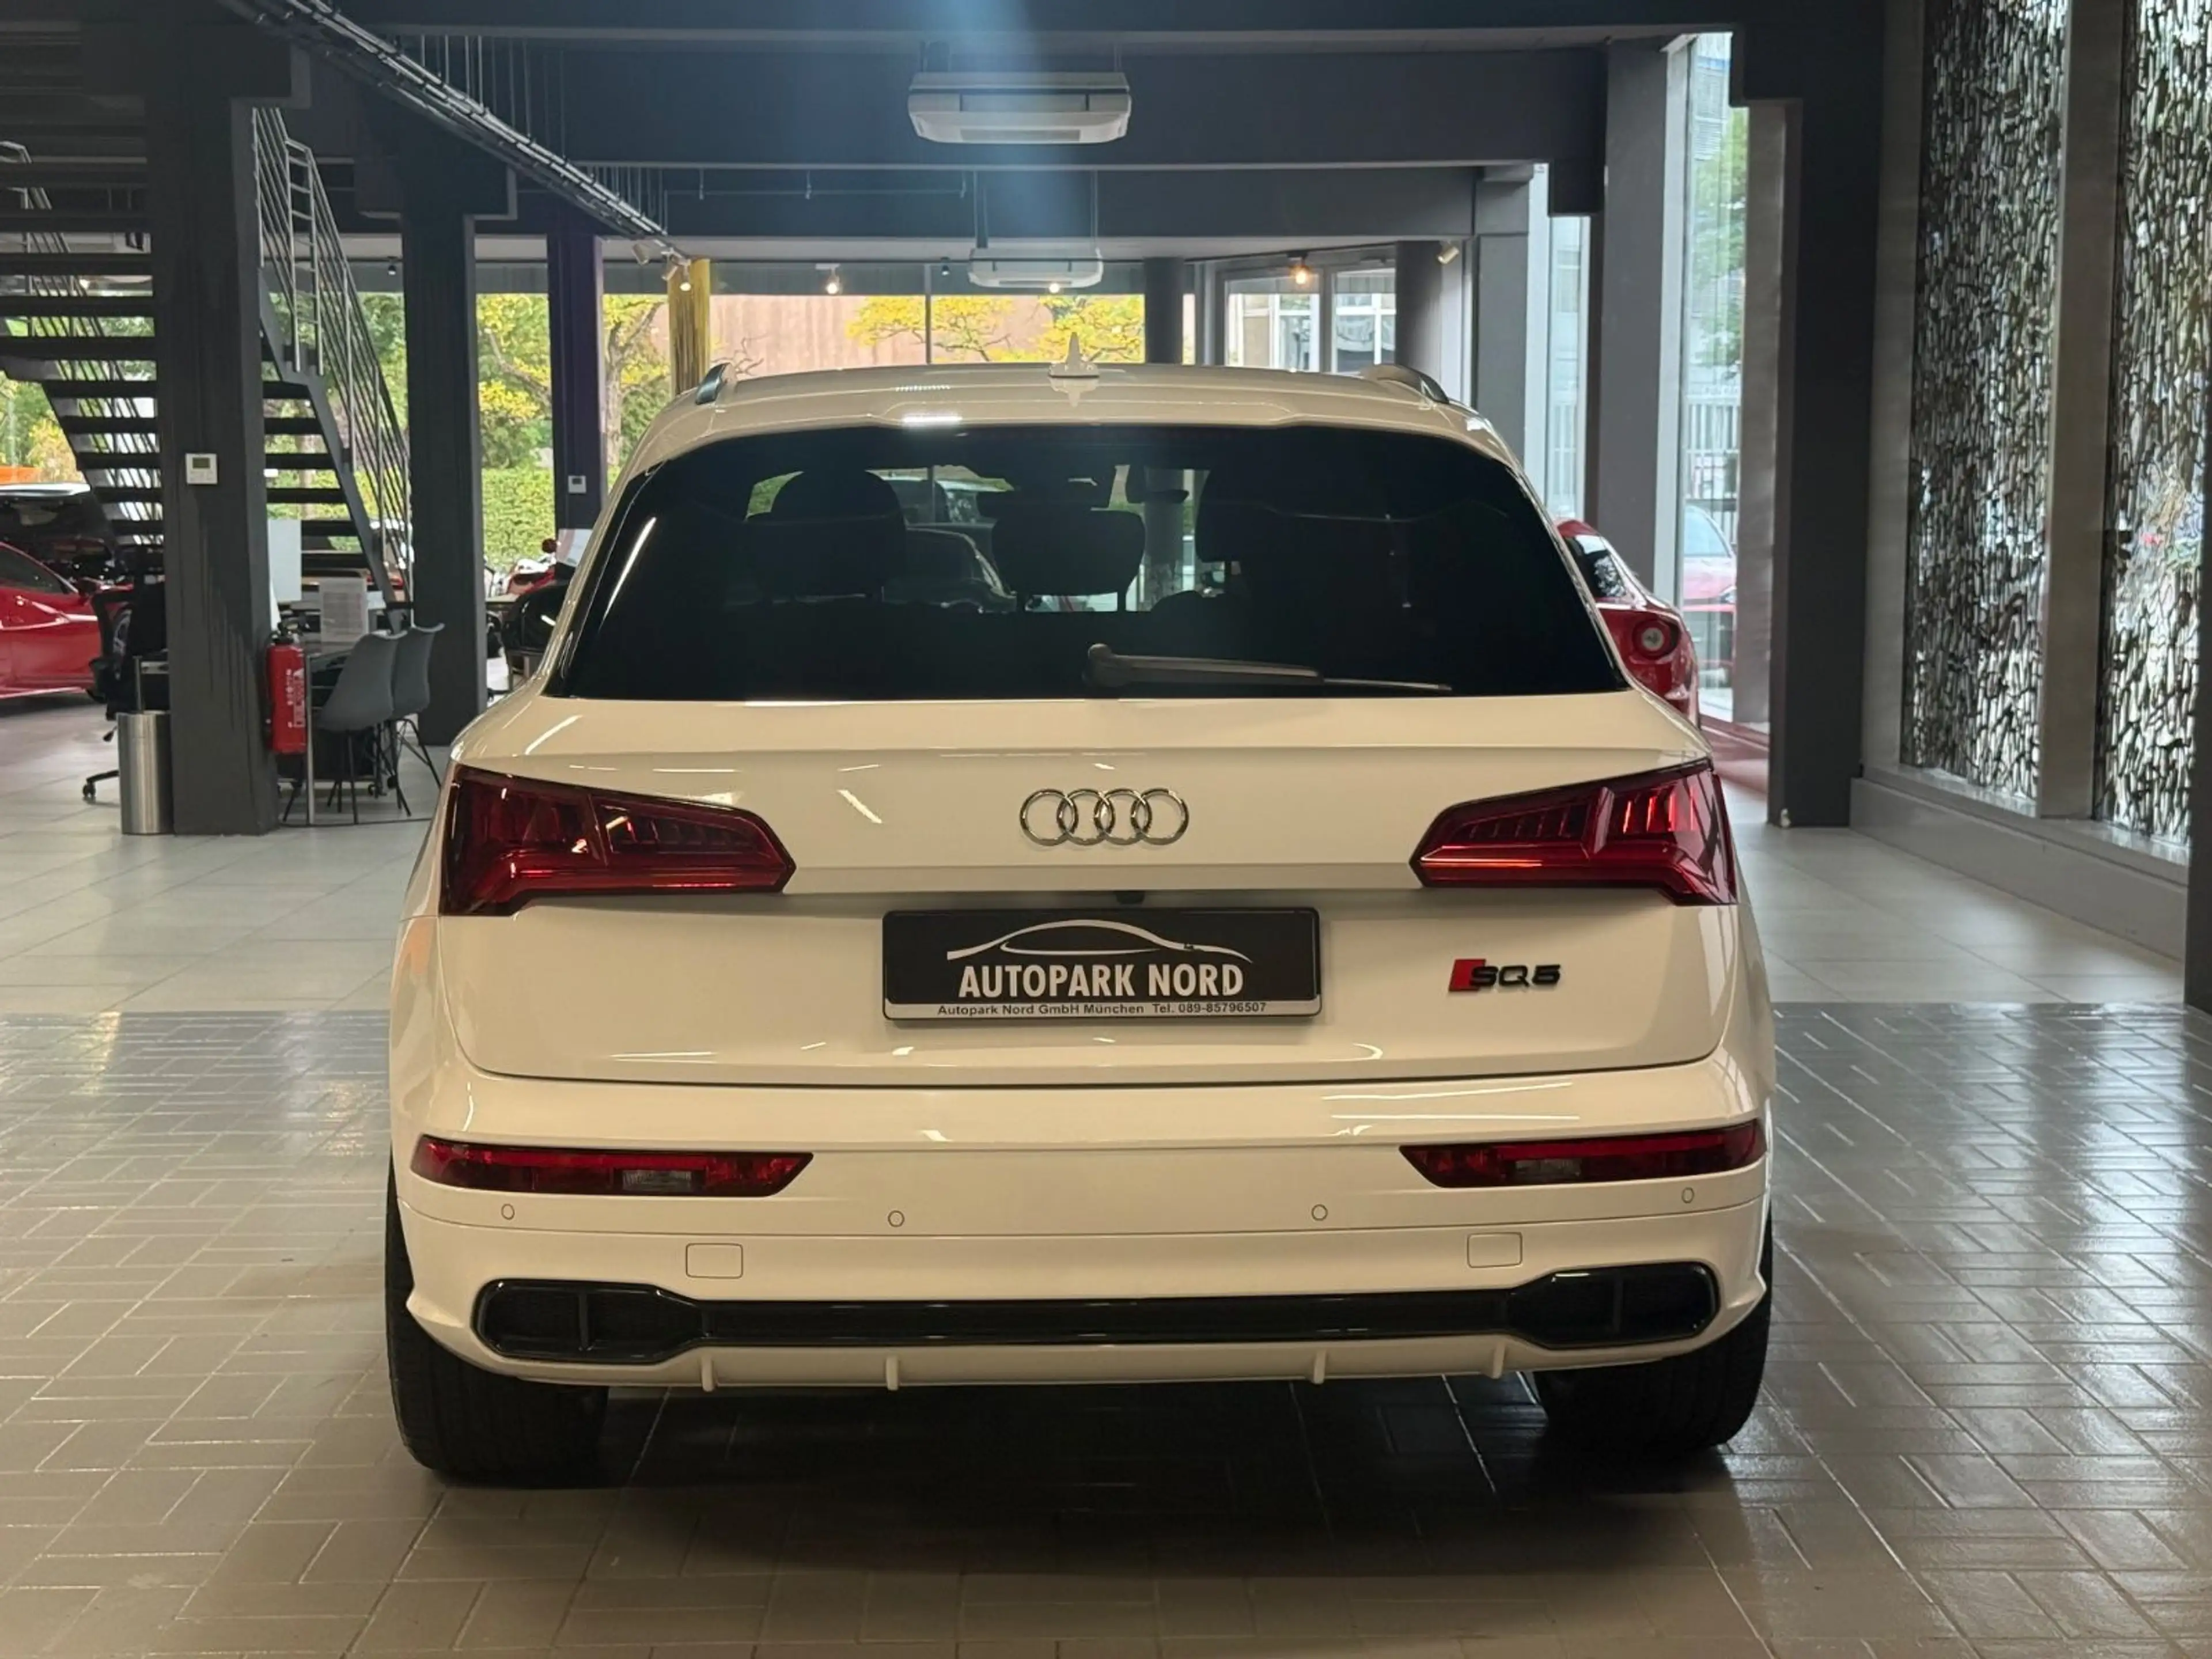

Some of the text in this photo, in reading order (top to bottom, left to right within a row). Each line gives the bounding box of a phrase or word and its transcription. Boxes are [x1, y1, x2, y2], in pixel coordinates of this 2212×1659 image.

[959, 963, 1244, 998] AUTOPARK NORD
[1471, 964, 1561, 988] SQ5
[937, 1002, 1267, 1017] Autopark Nord GmbH München Tel. 089-85796507
